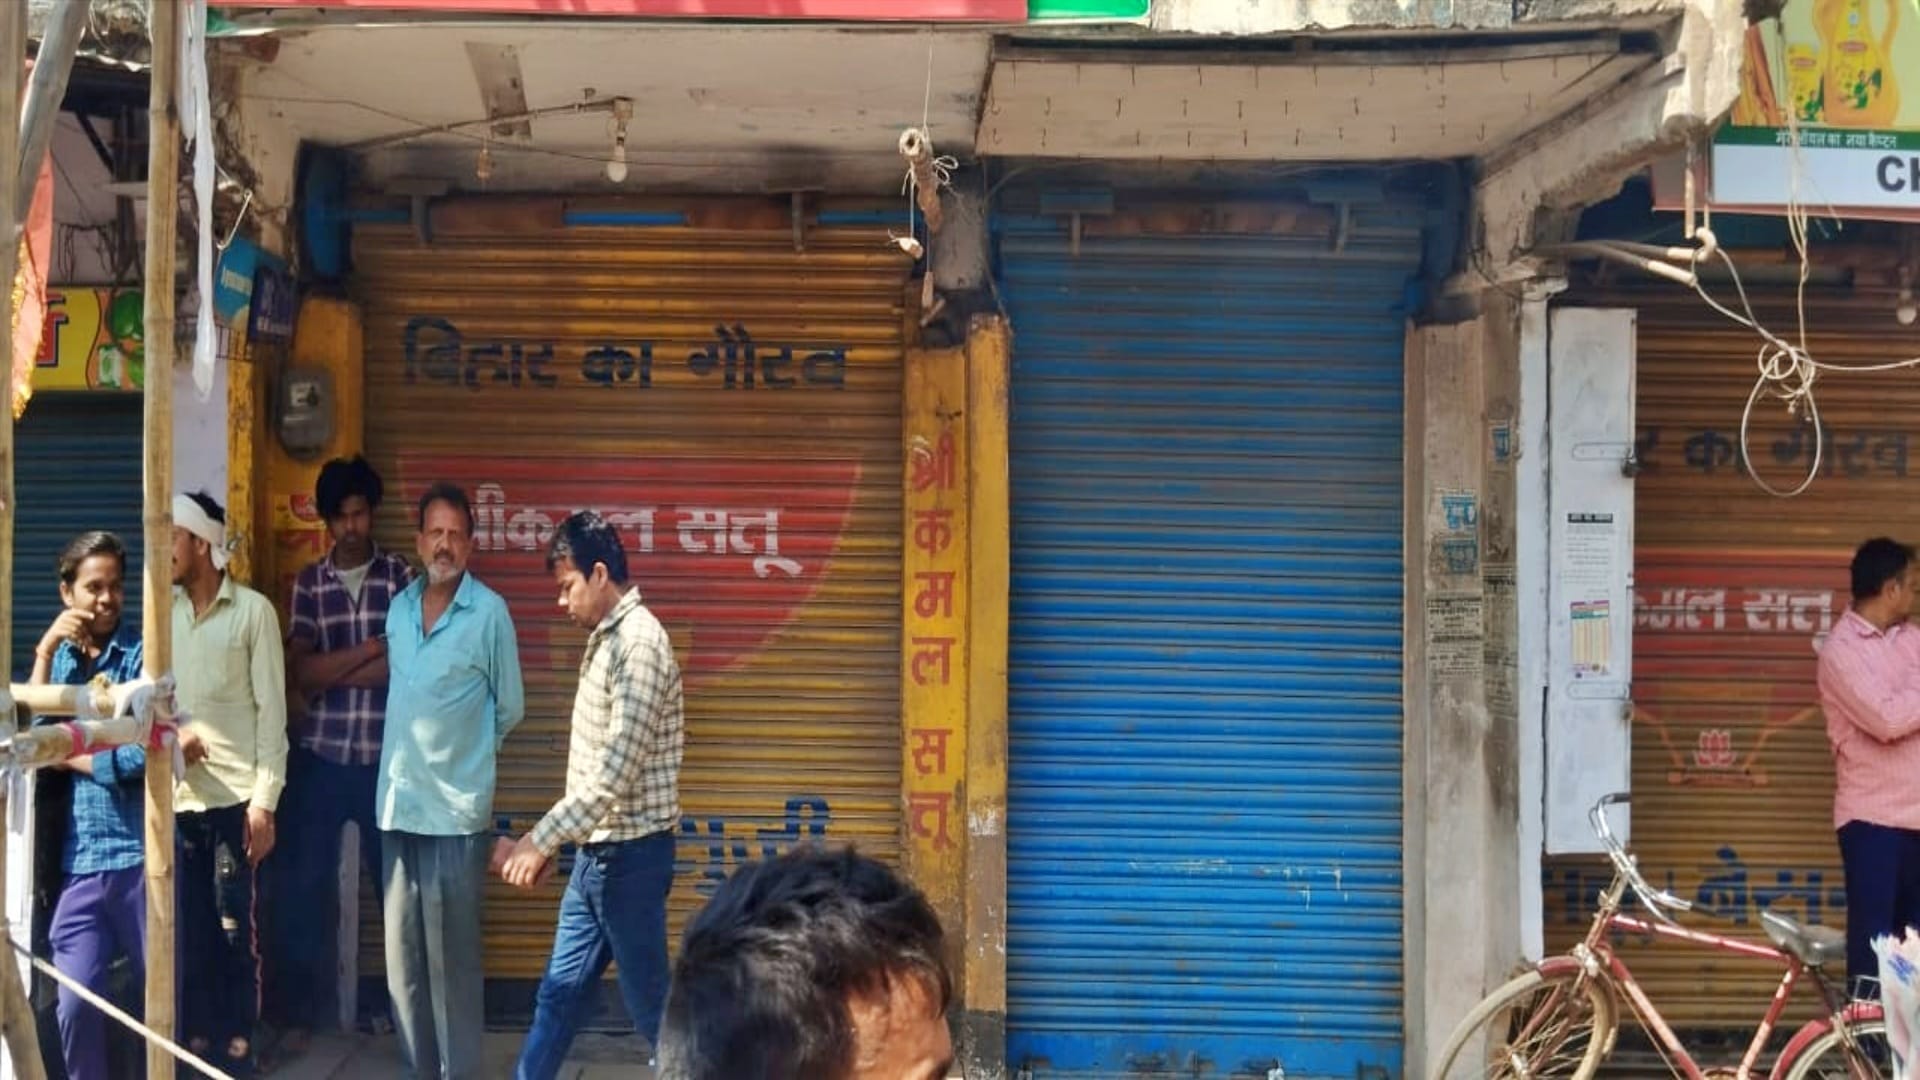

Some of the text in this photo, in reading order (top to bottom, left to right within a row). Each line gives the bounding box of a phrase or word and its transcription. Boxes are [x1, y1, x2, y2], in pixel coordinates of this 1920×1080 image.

[404, 316, 853, 391] बिहार का गौरव
